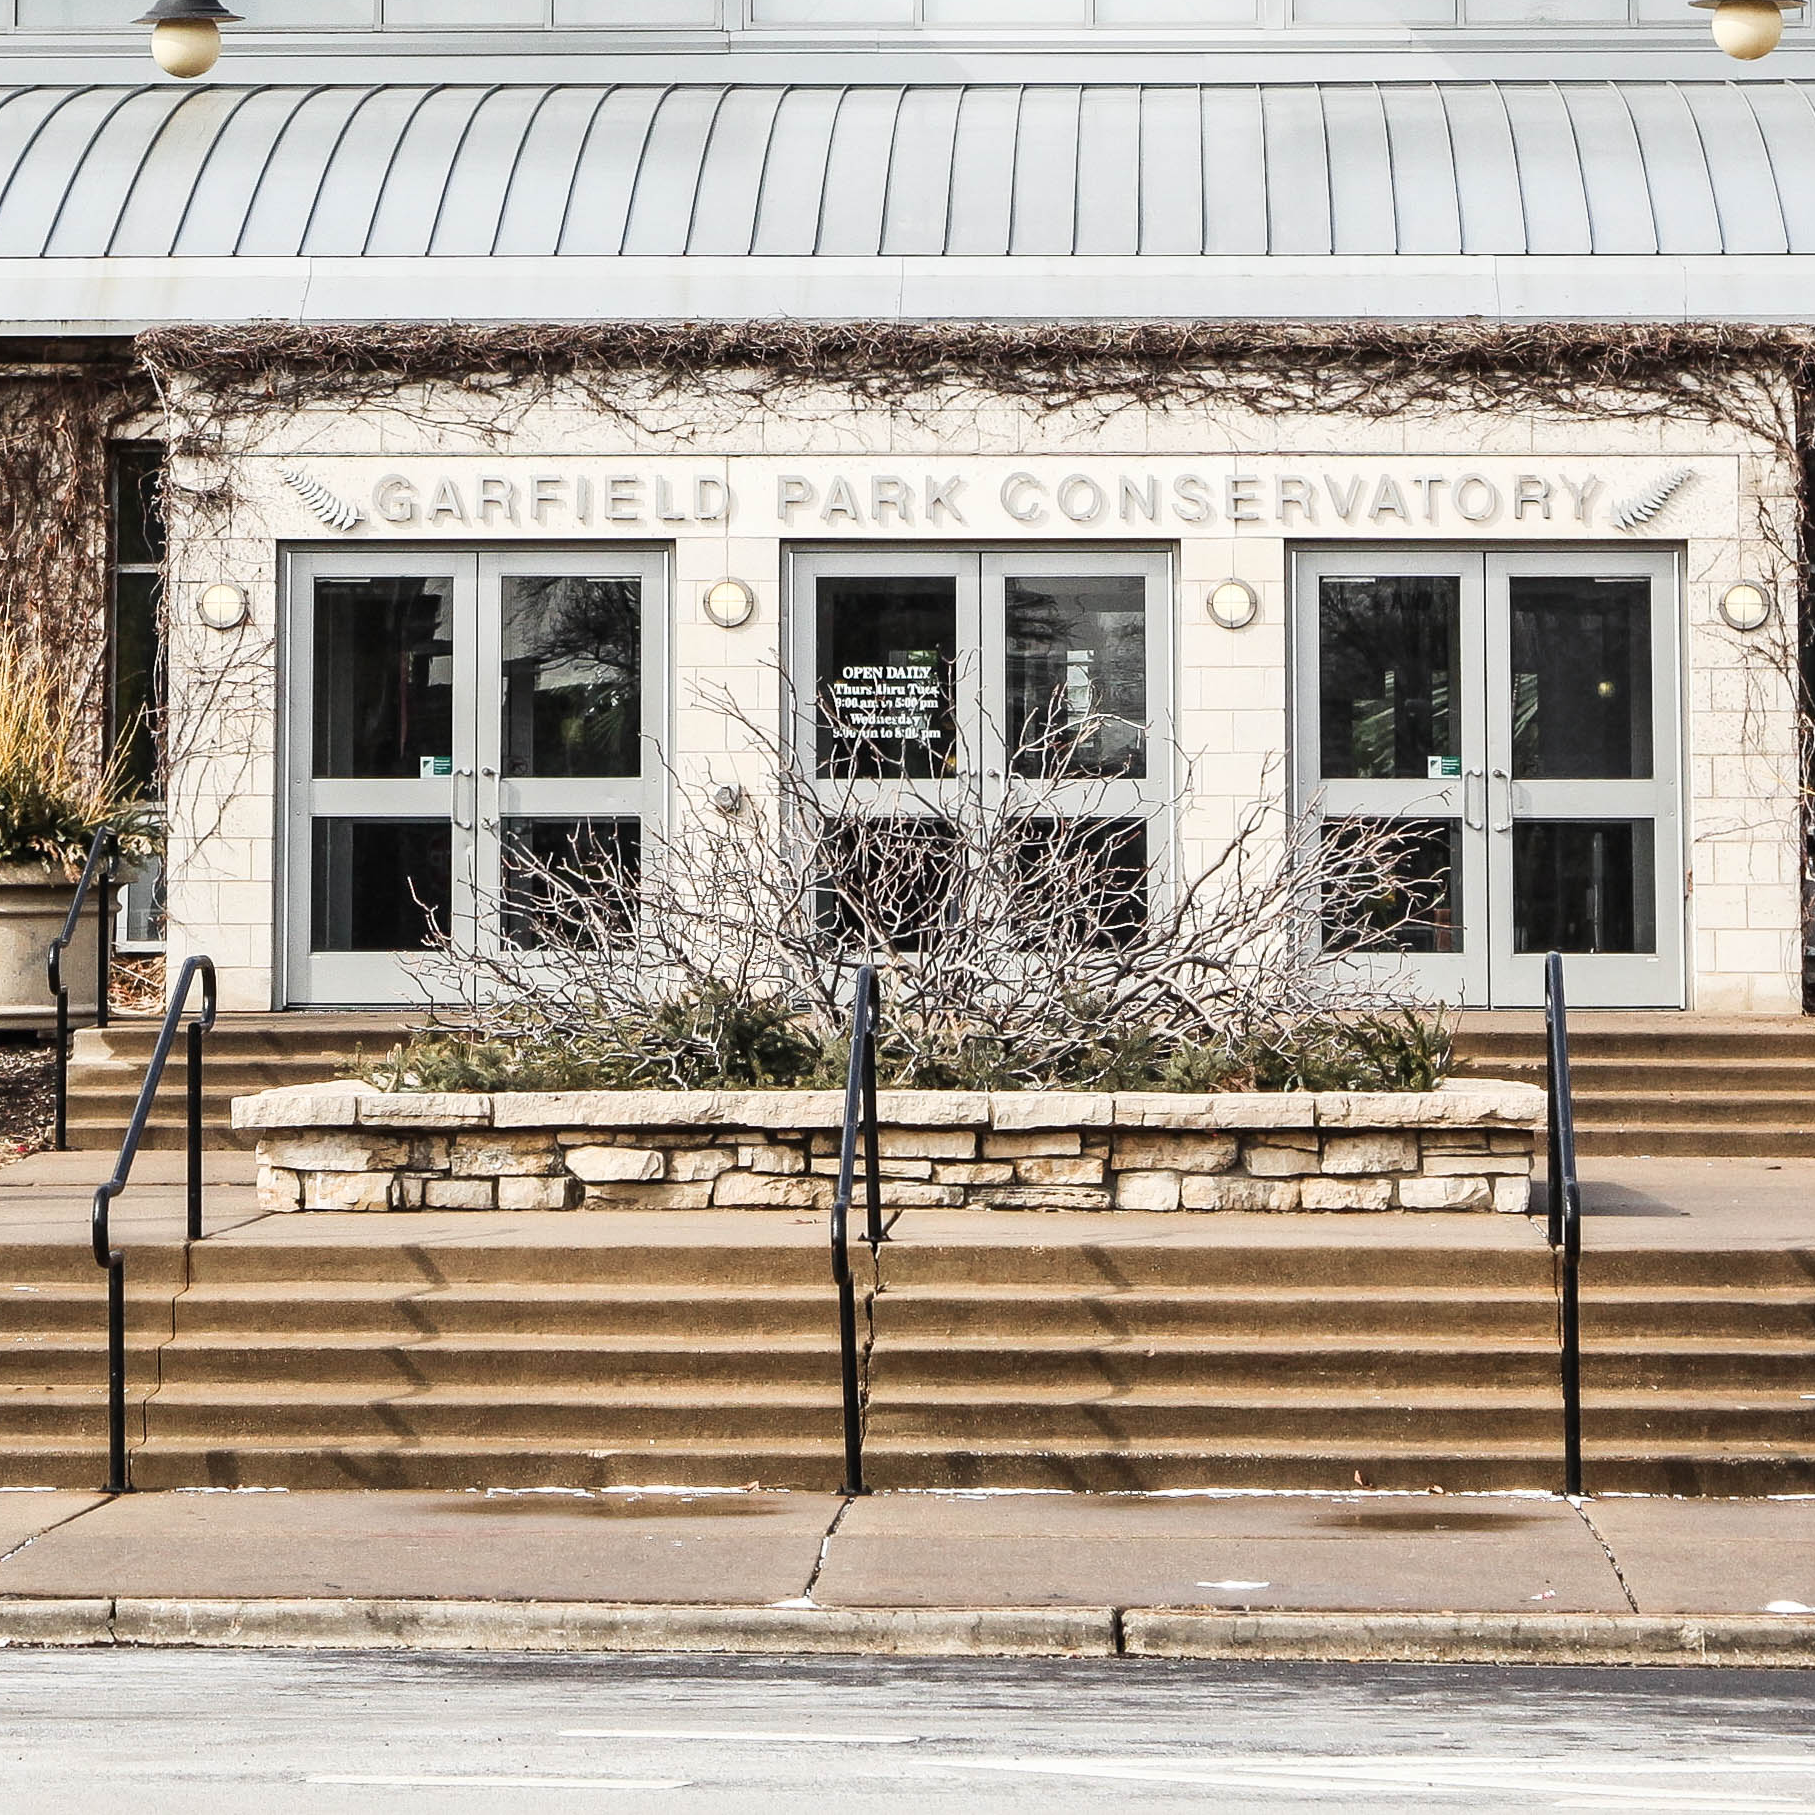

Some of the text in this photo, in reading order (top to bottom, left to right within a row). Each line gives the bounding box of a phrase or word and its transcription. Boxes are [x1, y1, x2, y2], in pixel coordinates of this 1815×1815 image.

[372, 471, 1600, 522] GARFIELD PARK CONSERVATORY
[842, 666, 932, 679] OPEN DAILY
[920, 699, 938, 711] pm
[881, 728, 893, 738] to
[921, 729, 941, 741] pm
